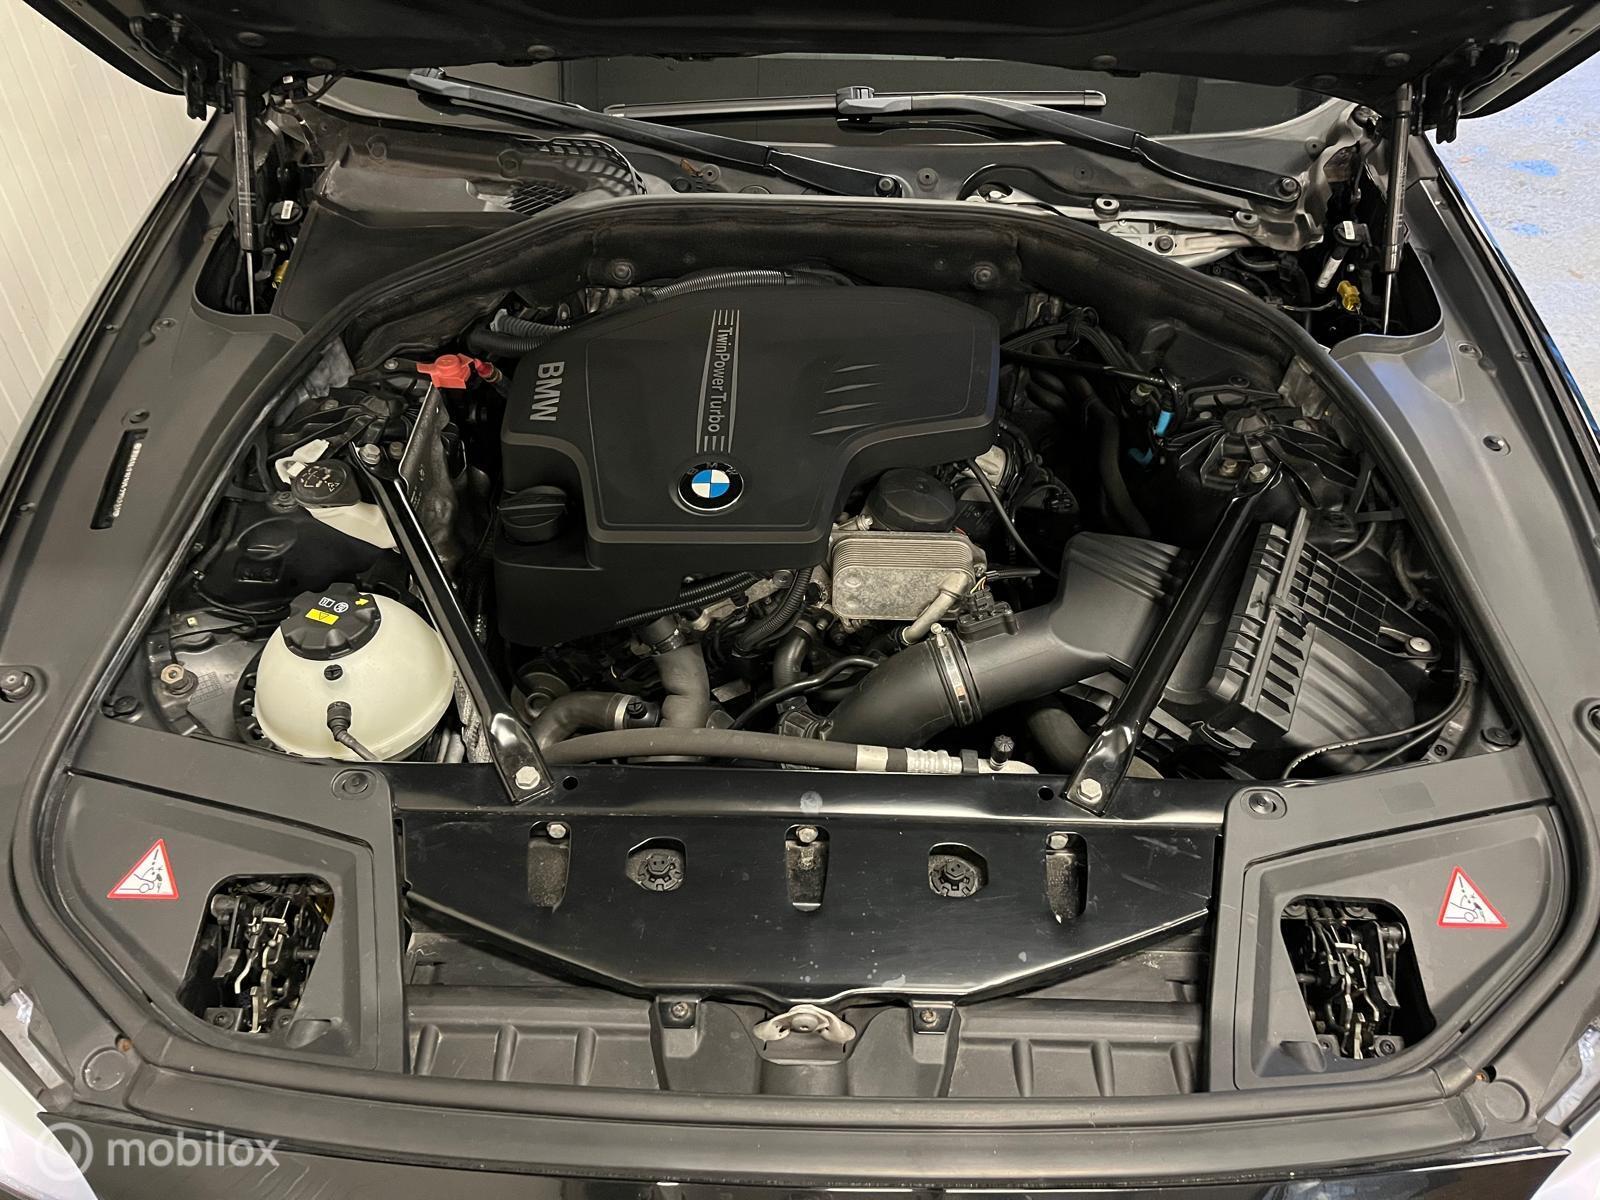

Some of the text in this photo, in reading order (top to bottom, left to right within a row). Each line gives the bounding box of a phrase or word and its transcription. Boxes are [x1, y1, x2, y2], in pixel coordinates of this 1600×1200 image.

[529, 360, 565, 422] BMW
[707, 326, 733, 433] TwinPower Turbo
